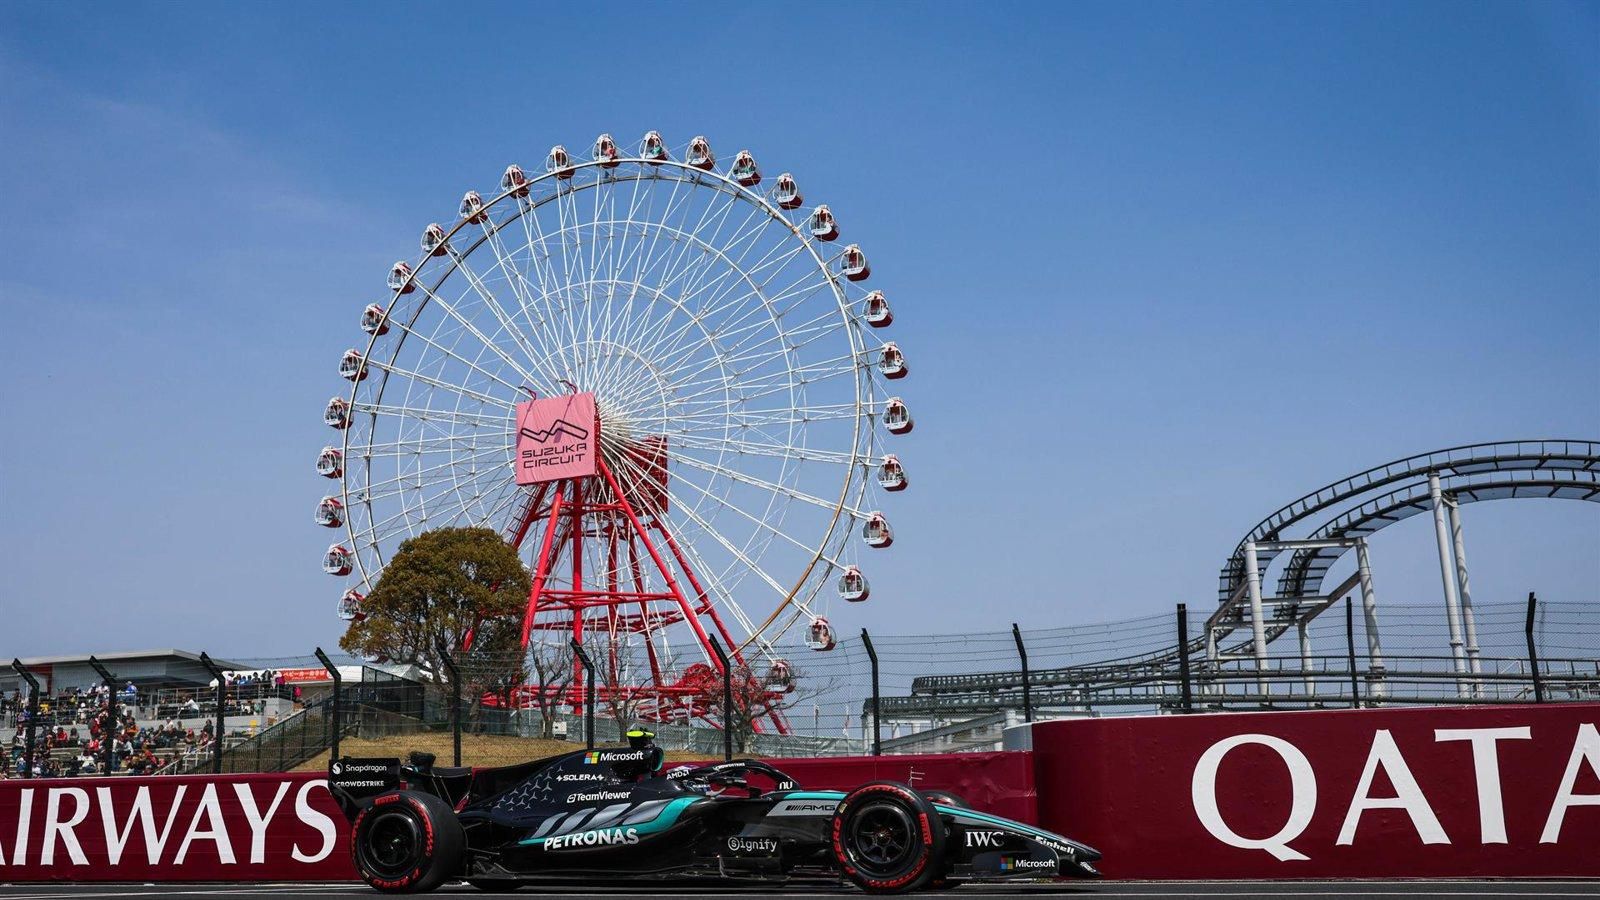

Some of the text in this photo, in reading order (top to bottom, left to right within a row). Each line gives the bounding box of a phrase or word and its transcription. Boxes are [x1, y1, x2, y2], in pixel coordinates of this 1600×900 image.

[522, 442, 587, 458] SUZUKA
[523, 453, 585, 469] CIRCUIT
[600, 750, 644, 761] Microsoft
[345, 764, 387, 773] Snapdragon
[666, 770, 683, 780] AMD
[336, 780, 385, 788] CROWDSTRIKE
[577, 790, 631, 802] TeamViewer
[0, 779, 337, 866] IRWAYS
[543, 828, 640, 851] PETRONAS
[965, 831, 1005, 847] IWC
[1035, 835, 1075, 855] Einhell
[1015, 859, 1055, 868] Microsoft
